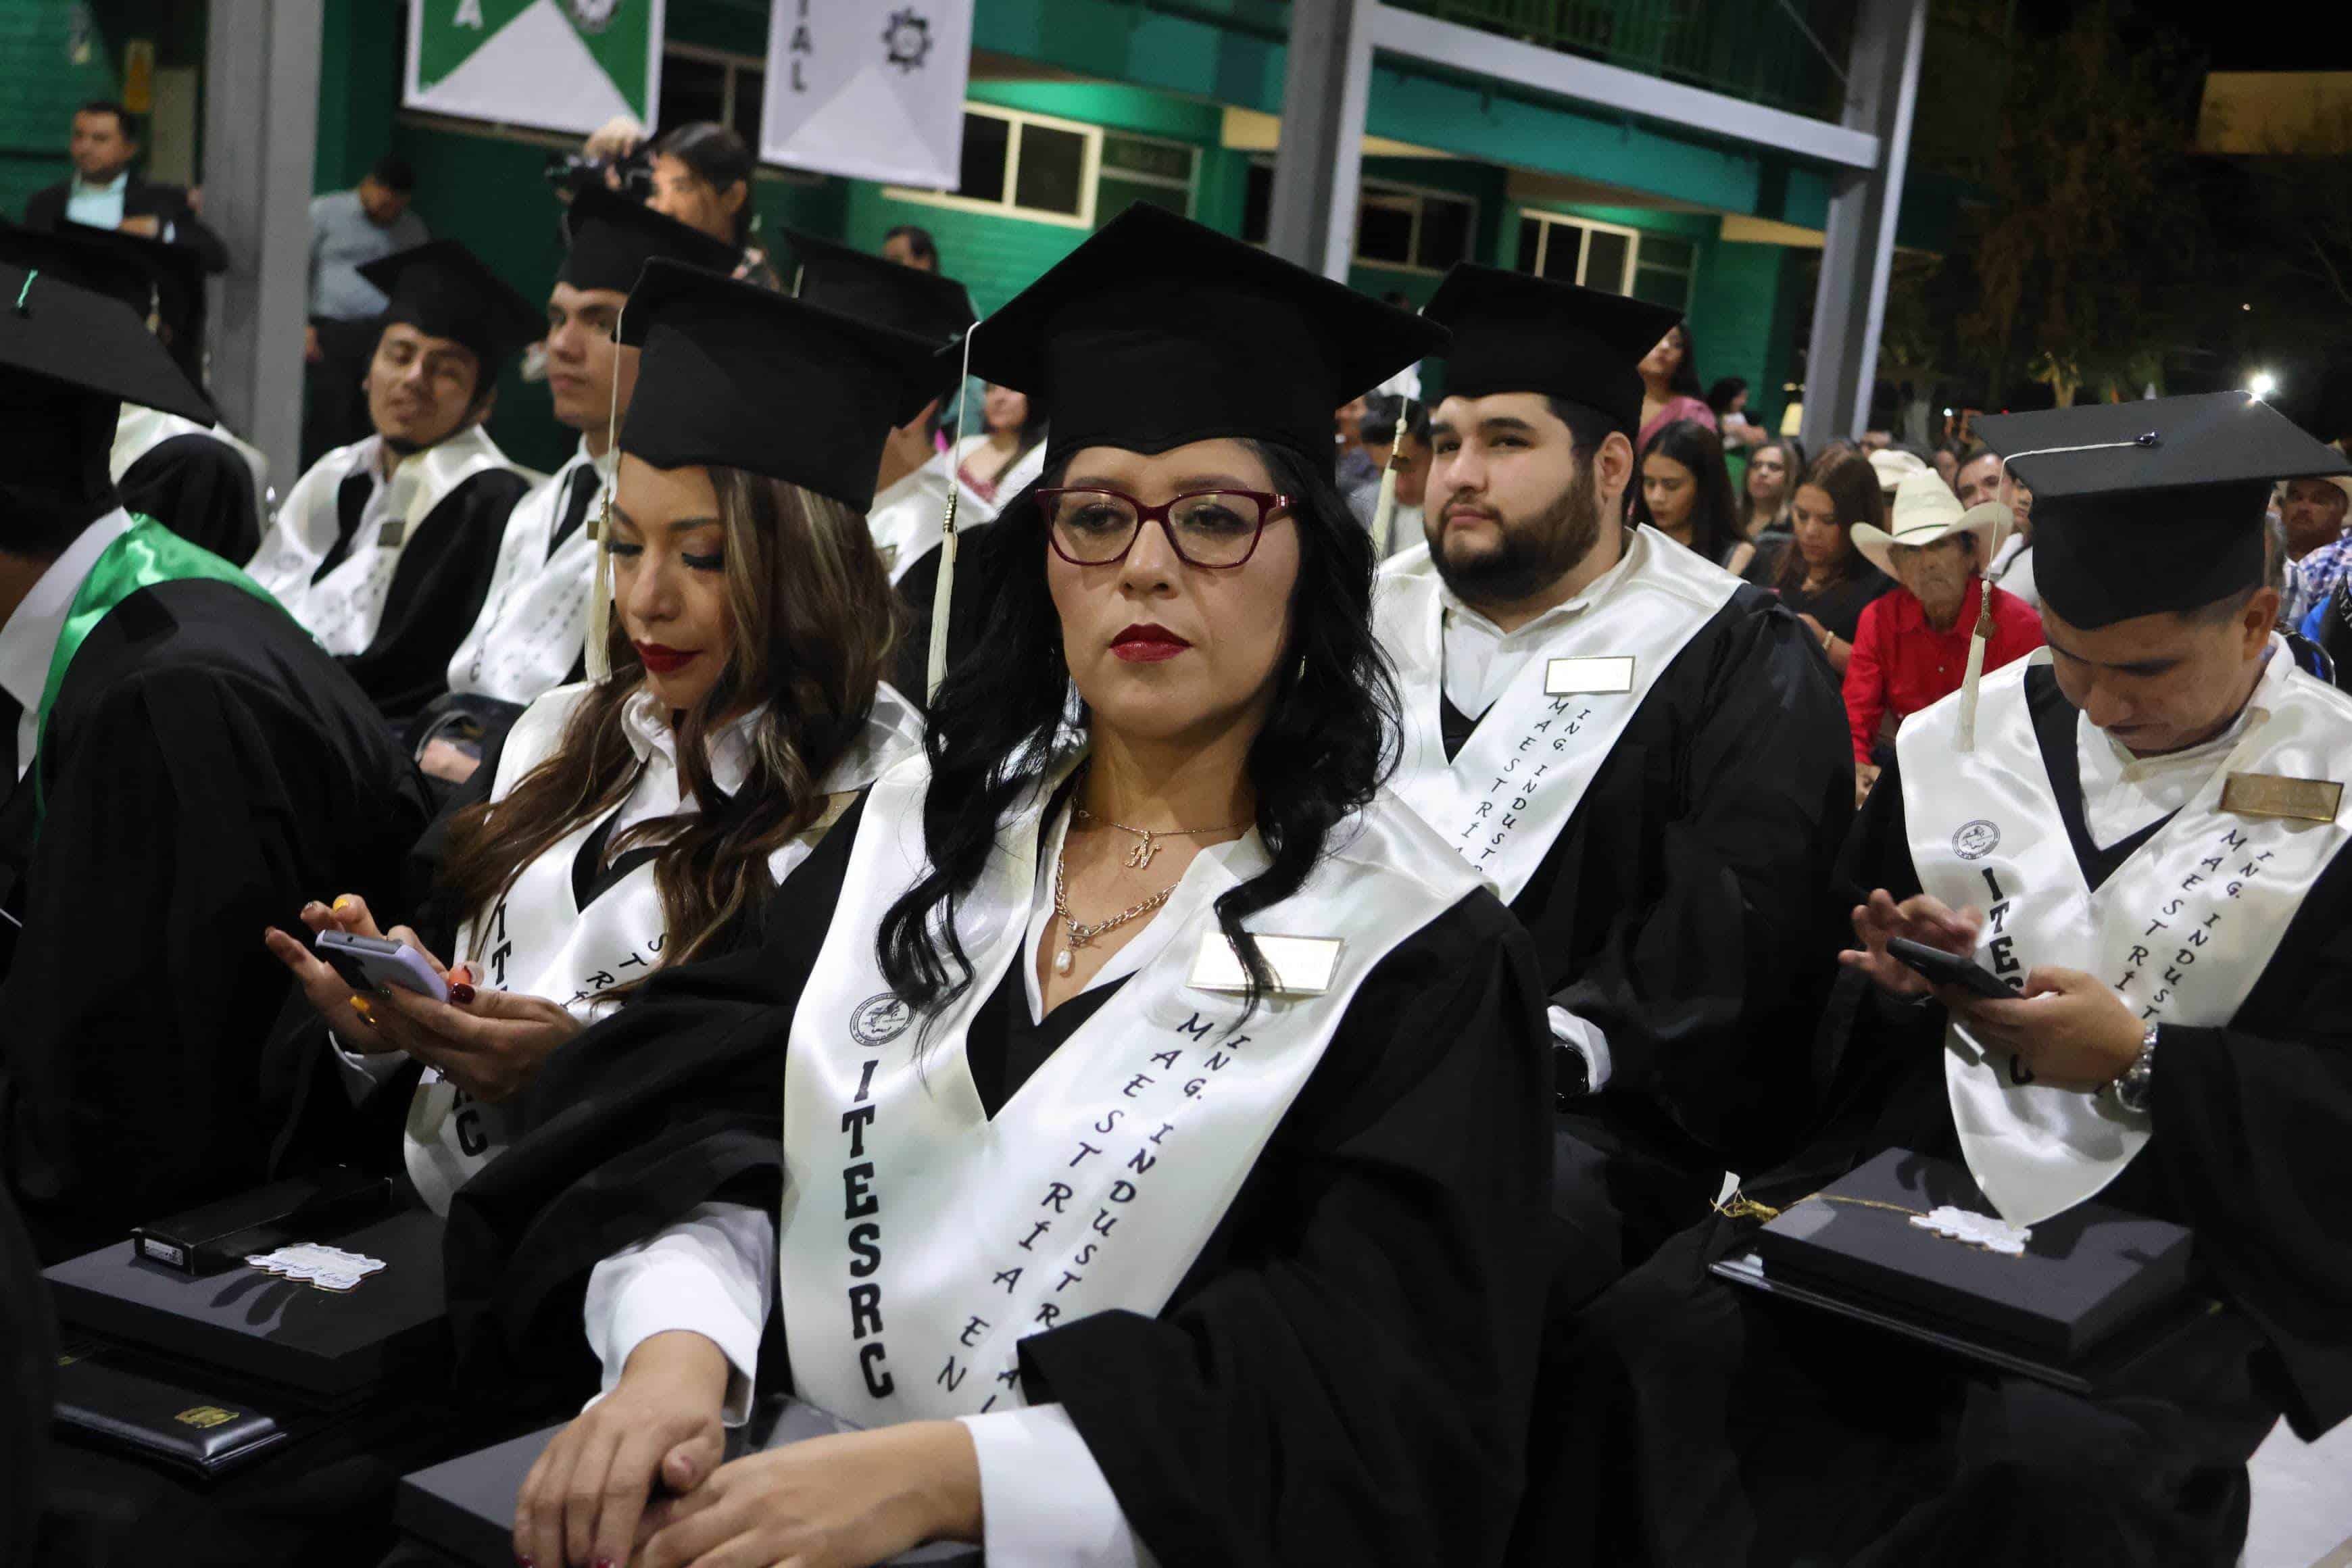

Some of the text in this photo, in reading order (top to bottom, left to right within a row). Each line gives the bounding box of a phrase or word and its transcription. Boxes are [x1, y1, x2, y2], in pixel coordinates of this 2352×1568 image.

[1552, 708, 1592, 752] ING.
[2226, 850, 2274, 899] ING.
[2113, 829, 2248, 992] MAESTRÍ
[1183, 1034, 1252, 1100] ING.
[841, 1060, 895, 1400] ITESRC
[937, 1316, 990, 1393] EN
